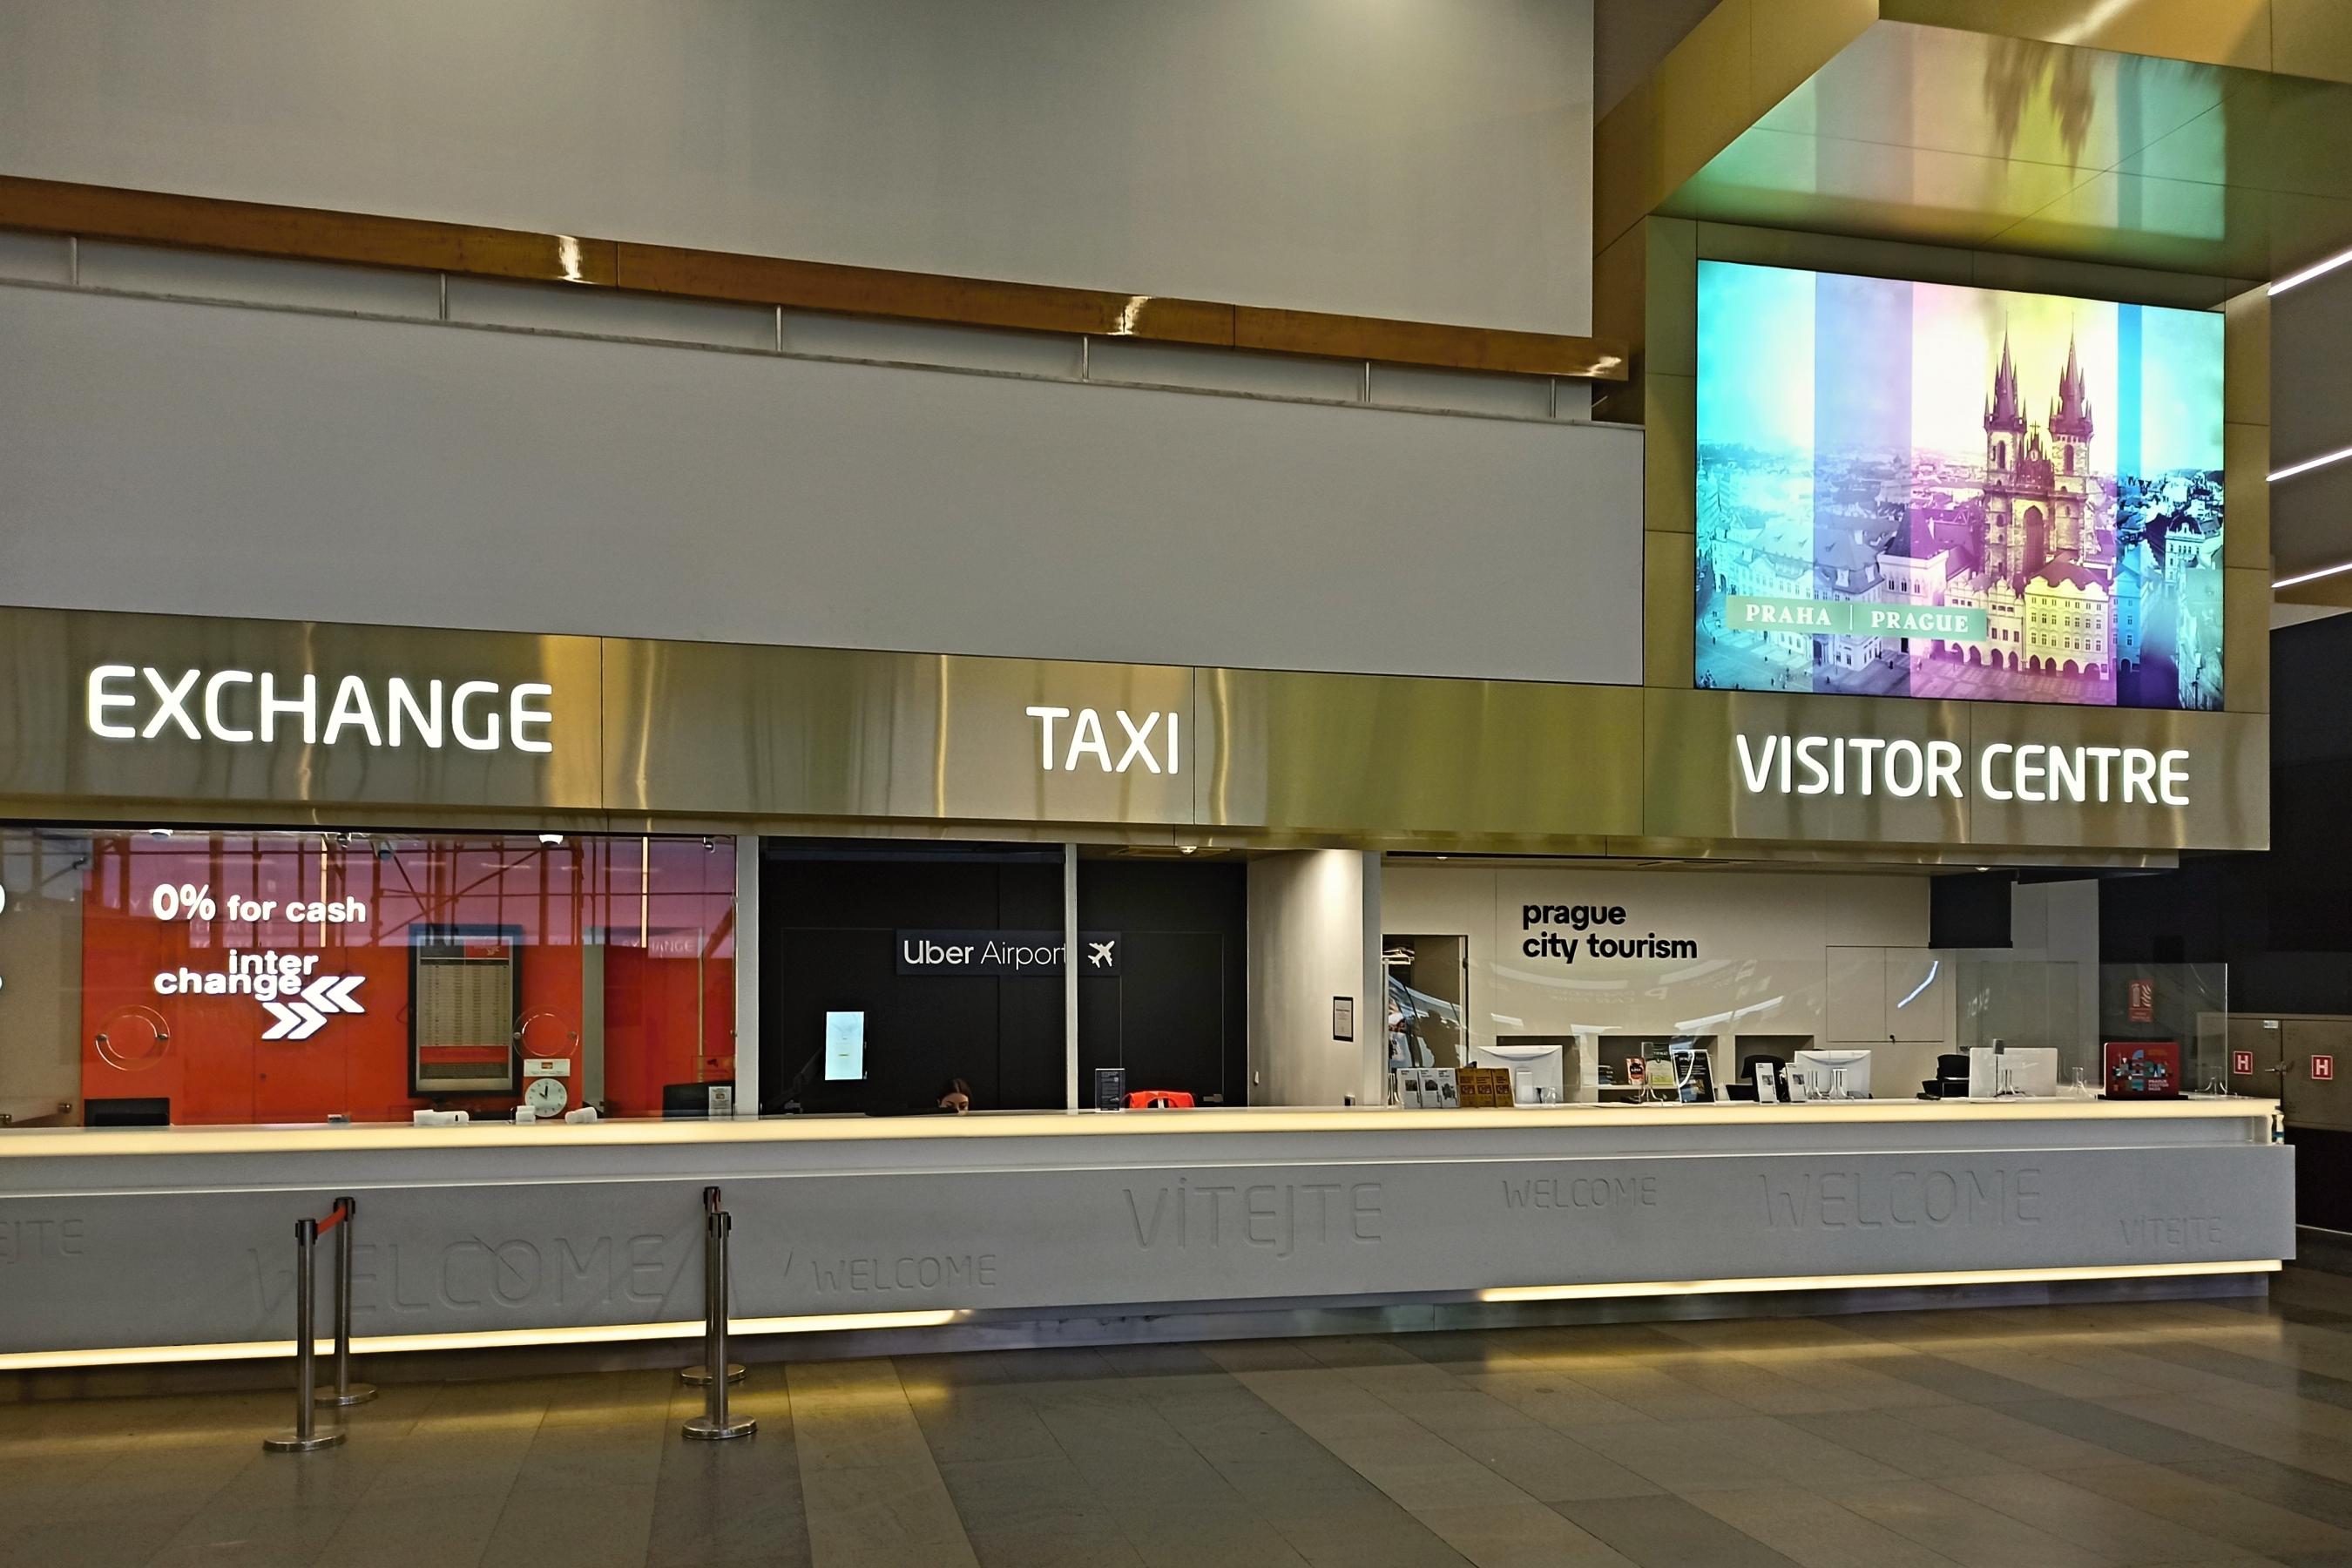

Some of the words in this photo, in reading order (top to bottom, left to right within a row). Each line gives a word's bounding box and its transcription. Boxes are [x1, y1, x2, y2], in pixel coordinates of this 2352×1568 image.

[1746, 604, 1831, 625] PRAHA
[1871, 611, 1969, 632] PRAGUE
[88, 665, 553, 753] EXCHANGE
[1026, 706, 1179, 774] TAXI
[1735, 734, 1963, 799] VISITOR
[1980, 743, 2190, 806] CENTRE
[152, 883, 216, 921] 0%
[227, 895, 277, 922] for
[286, 896, 366, 923] cash
[1523, 905, 1626, 931] prague
[229, 950, 319, 976] inter
[904, 940, 974, 964] Uber
[1523, 931, 1578, 964] city
[1586, 932, 1698, 959] tourism
[154, 967, 302, 1002] change
[2237, 1054, 2249, 1071] H
[2315, 1058, 2328, 1076] H
[1502, 1176, 1656, 1209] WELCOME
[1758, 1168, 2042, 1231] WELCOME
[811, 1254, 997, 1293] WELCOME
